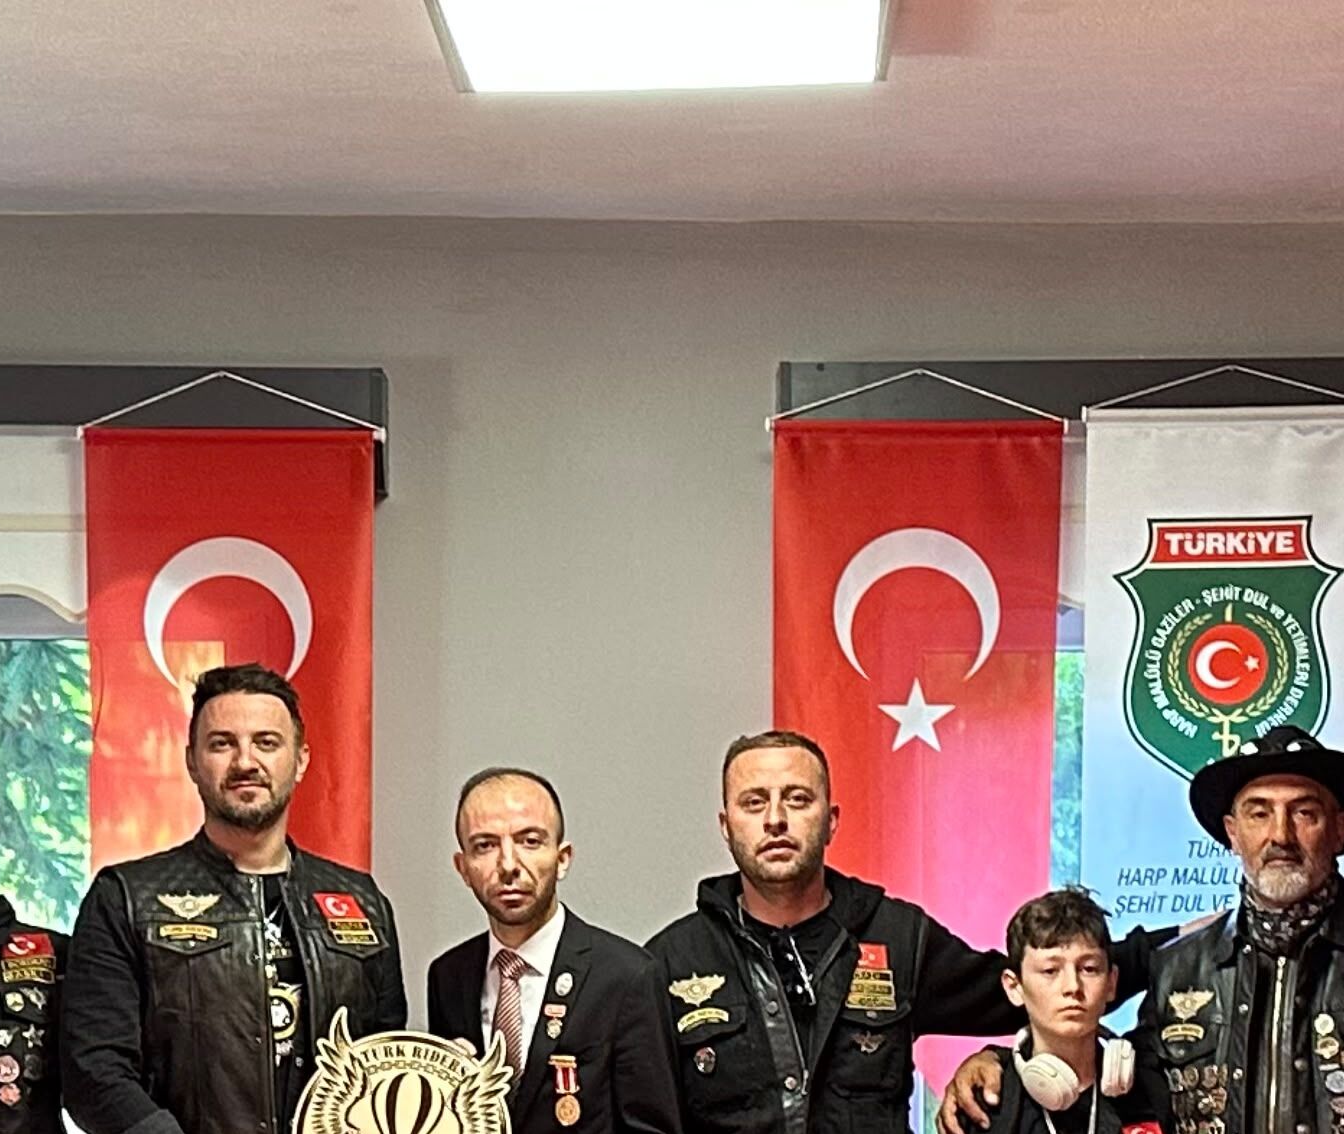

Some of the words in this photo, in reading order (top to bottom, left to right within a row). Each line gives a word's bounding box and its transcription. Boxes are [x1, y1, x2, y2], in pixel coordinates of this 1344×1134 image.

[1164, 531, 1295, 556] TÜRKİYE
[1243, 588, 1270, 610] DUL
[1150, 598, 1195, 649] GAZİLER
[1162, 708, 1198, 739] HARP
[1117, 867, 1167, 887] HARP
[1115, 892, 1168, 918] ŞEHİT
[1171, 894, 1205, 912] DUL
[1212, 893, 1235, 912] VE
[412, 1046, 470, 1077] RIDERS
